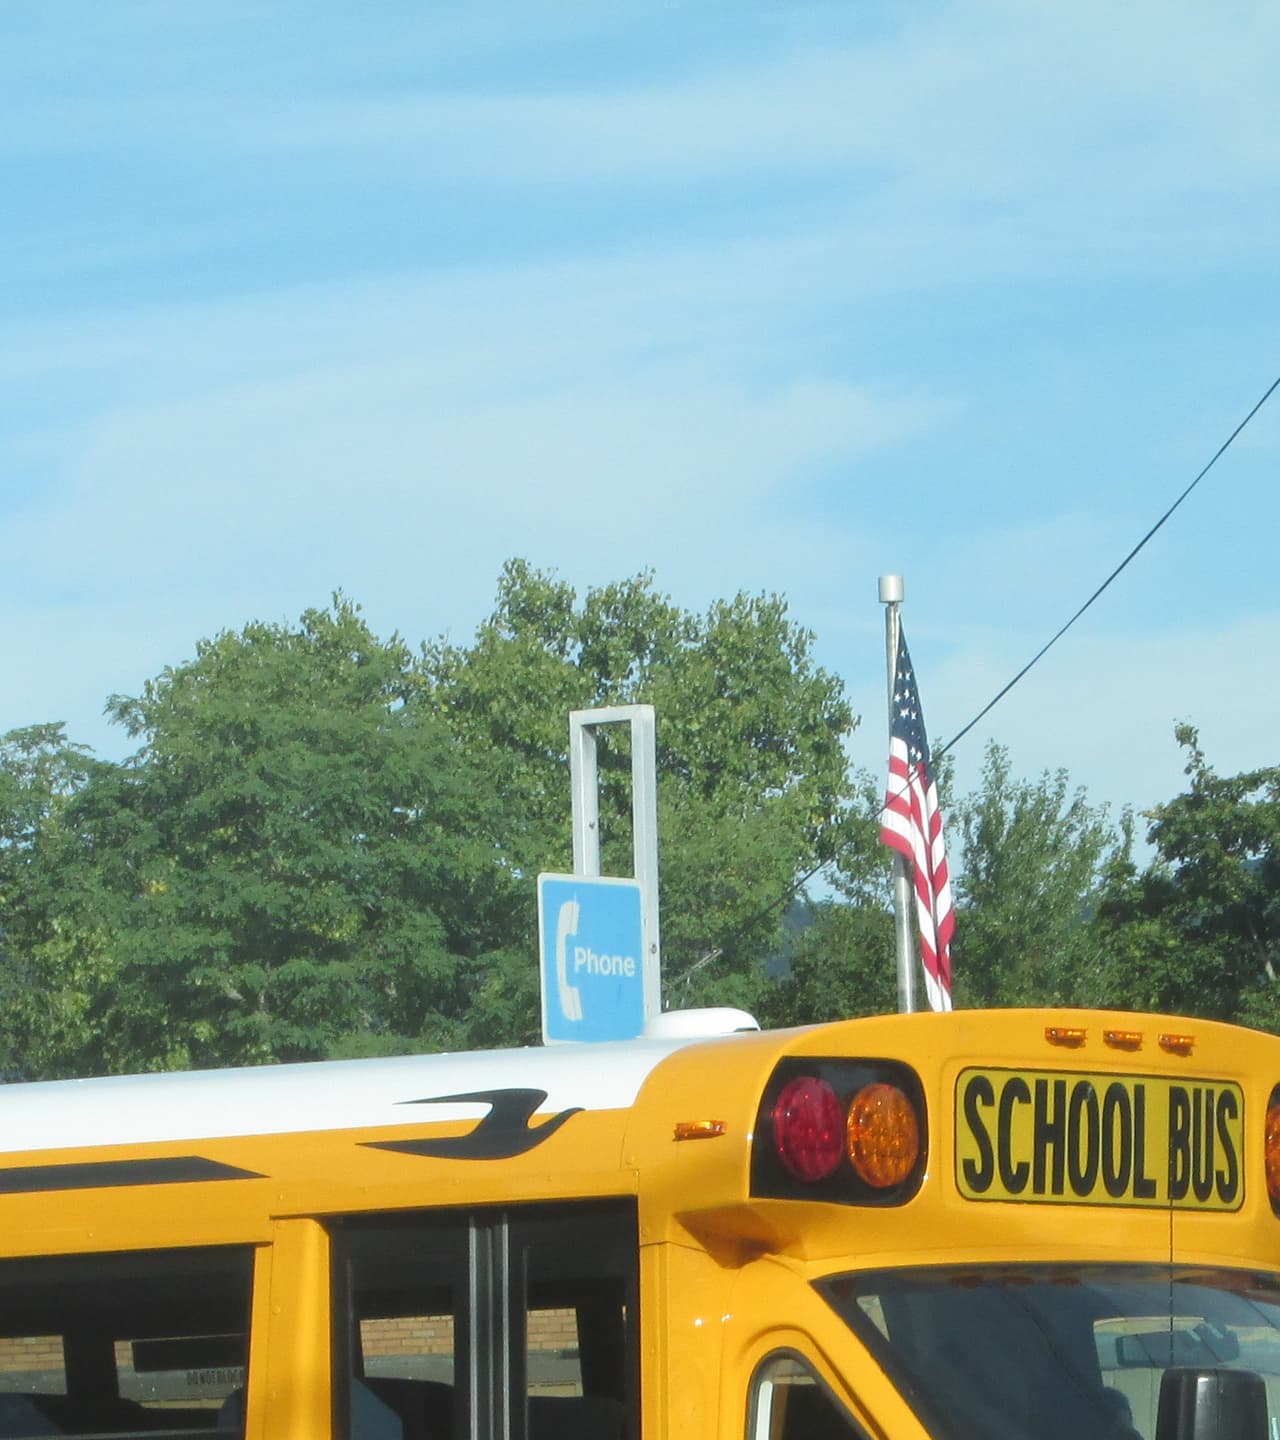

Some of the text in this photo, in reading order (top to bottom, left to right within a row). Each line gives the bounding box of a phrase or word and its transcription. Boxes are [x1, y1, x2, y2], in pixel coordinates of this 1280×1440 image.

[574, 947, 635, 977] Phone
[962, 1076, 1238, 1203] SCHOOL BUS
